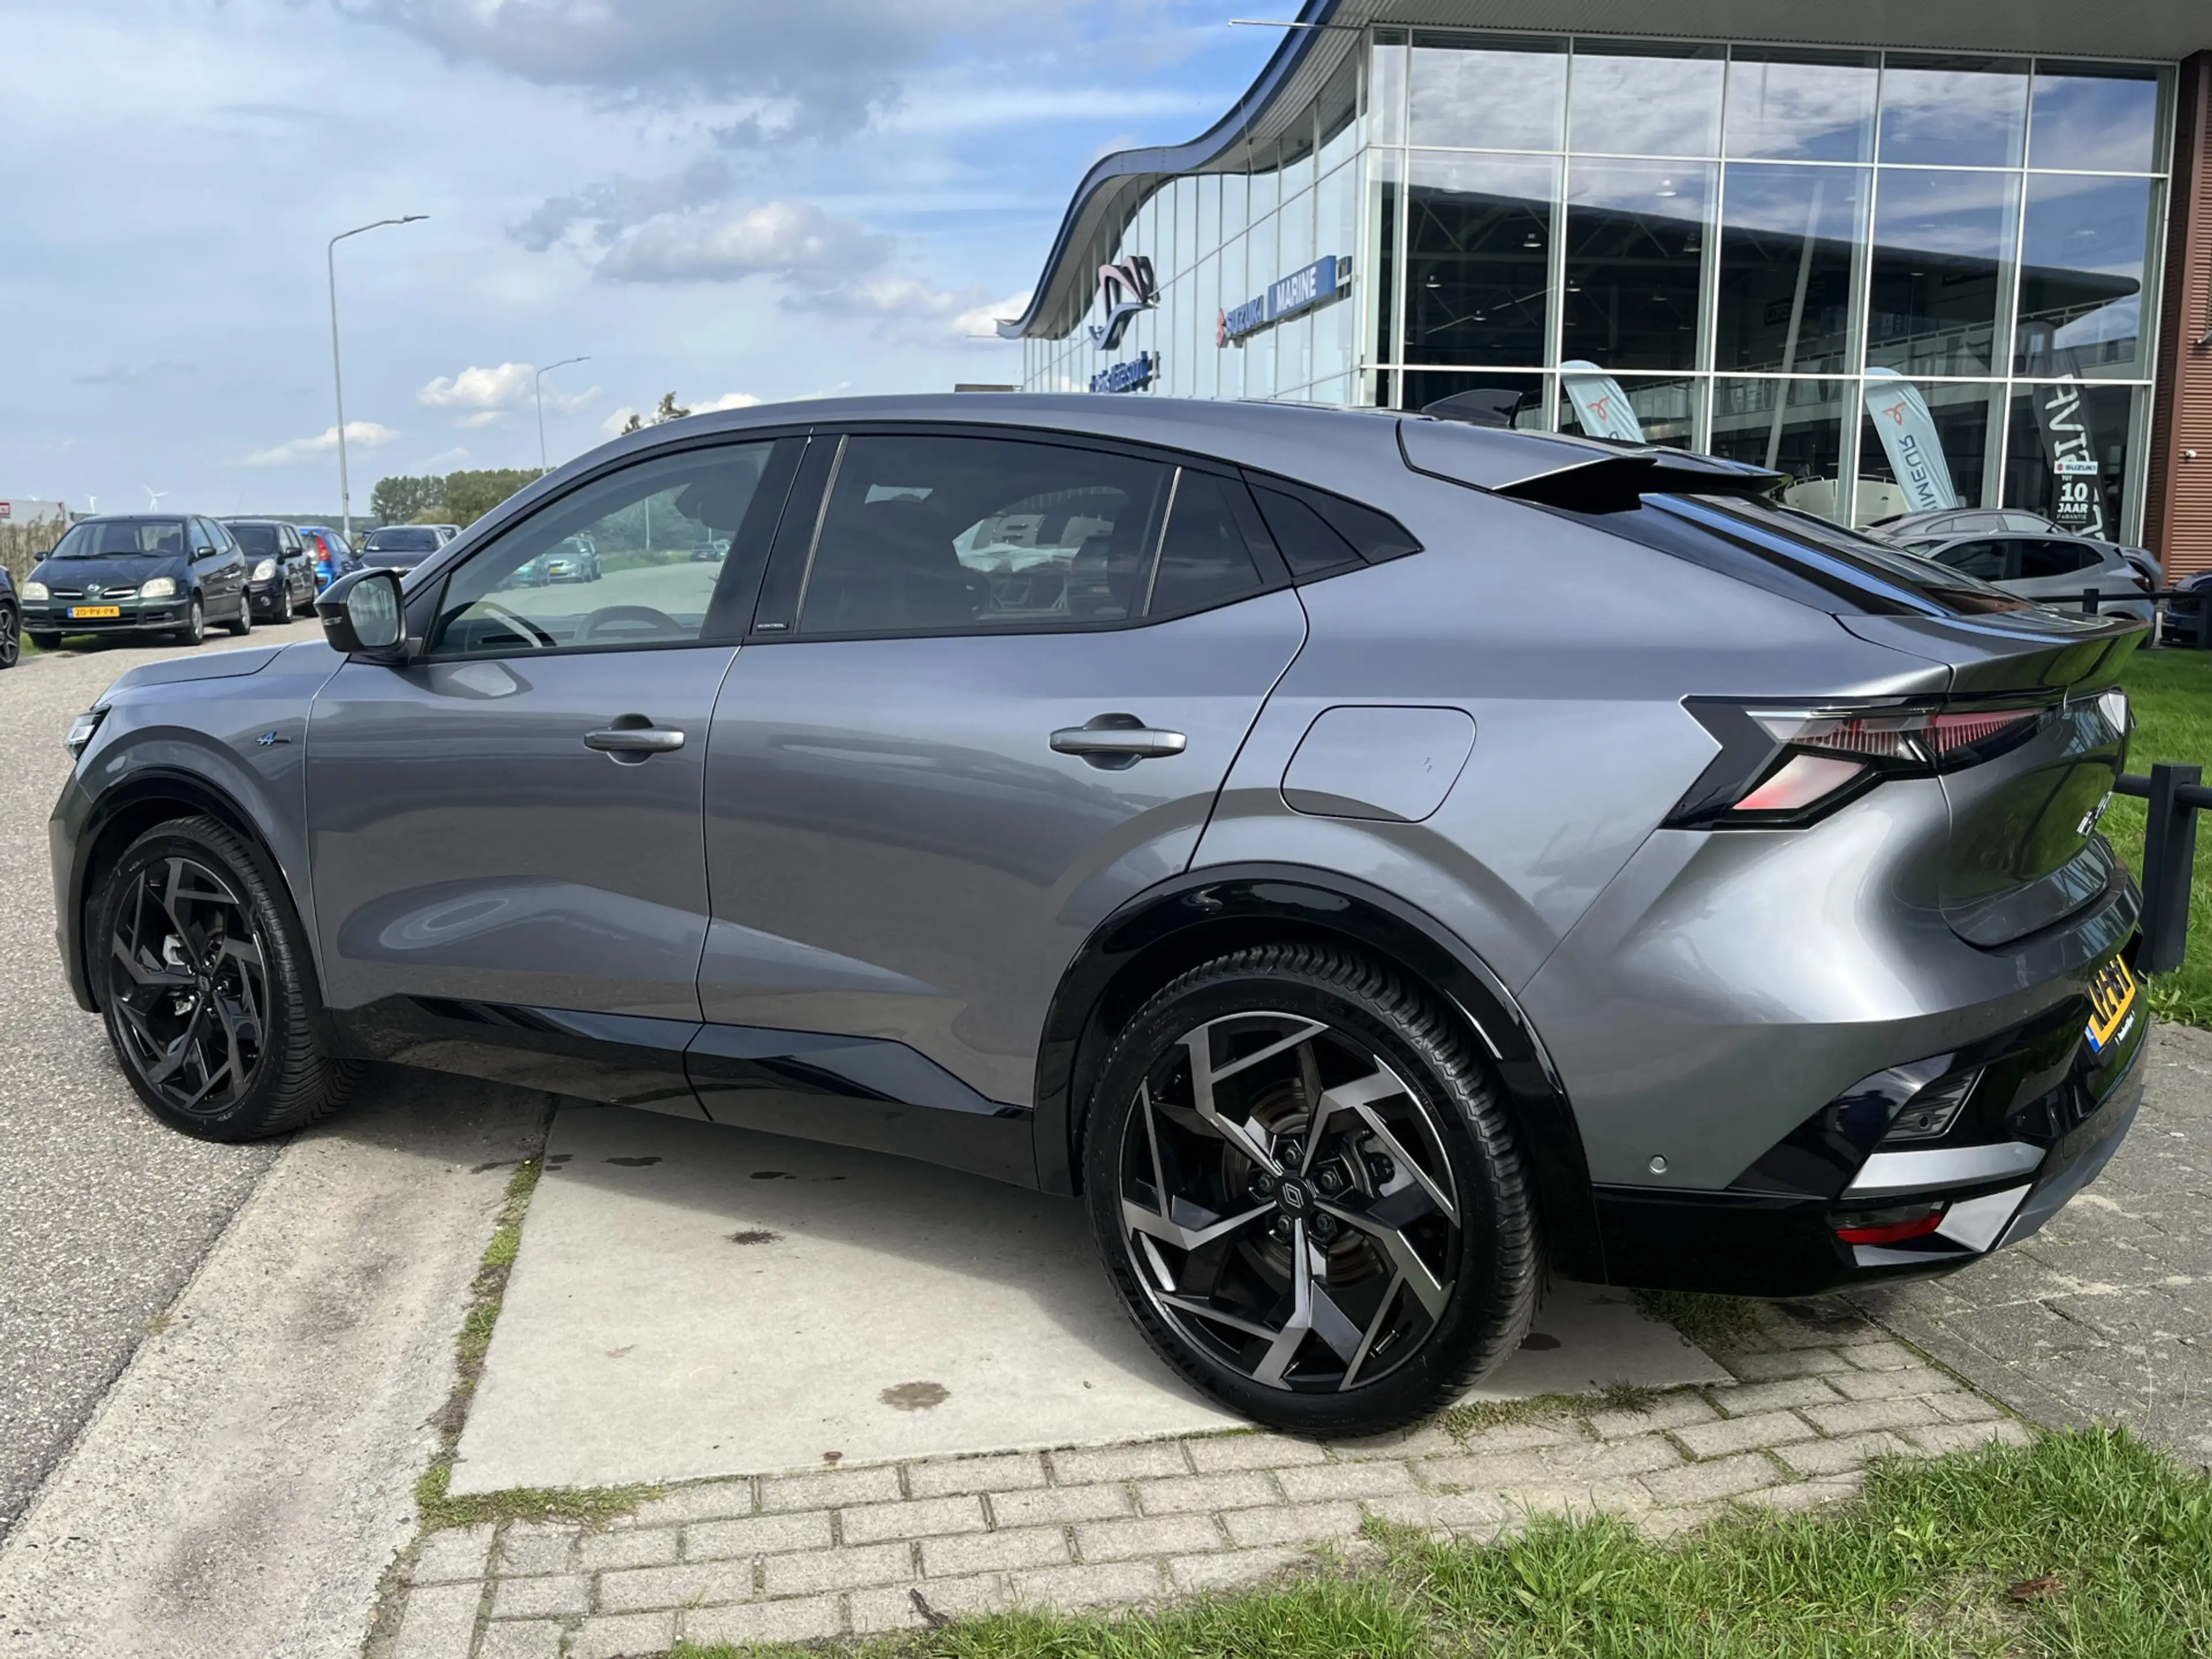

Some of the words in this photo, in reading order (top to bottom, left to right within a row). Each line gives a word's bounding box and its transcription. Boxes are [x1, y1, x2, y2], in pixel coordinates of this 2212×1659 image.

[1226, 294, 1264, 338] SUZUKI
[1276, 266, 1316, 313] MARINE
[2061, 483, 2088, 502] 10
[2057, 503, 2089, 513] JAAR
